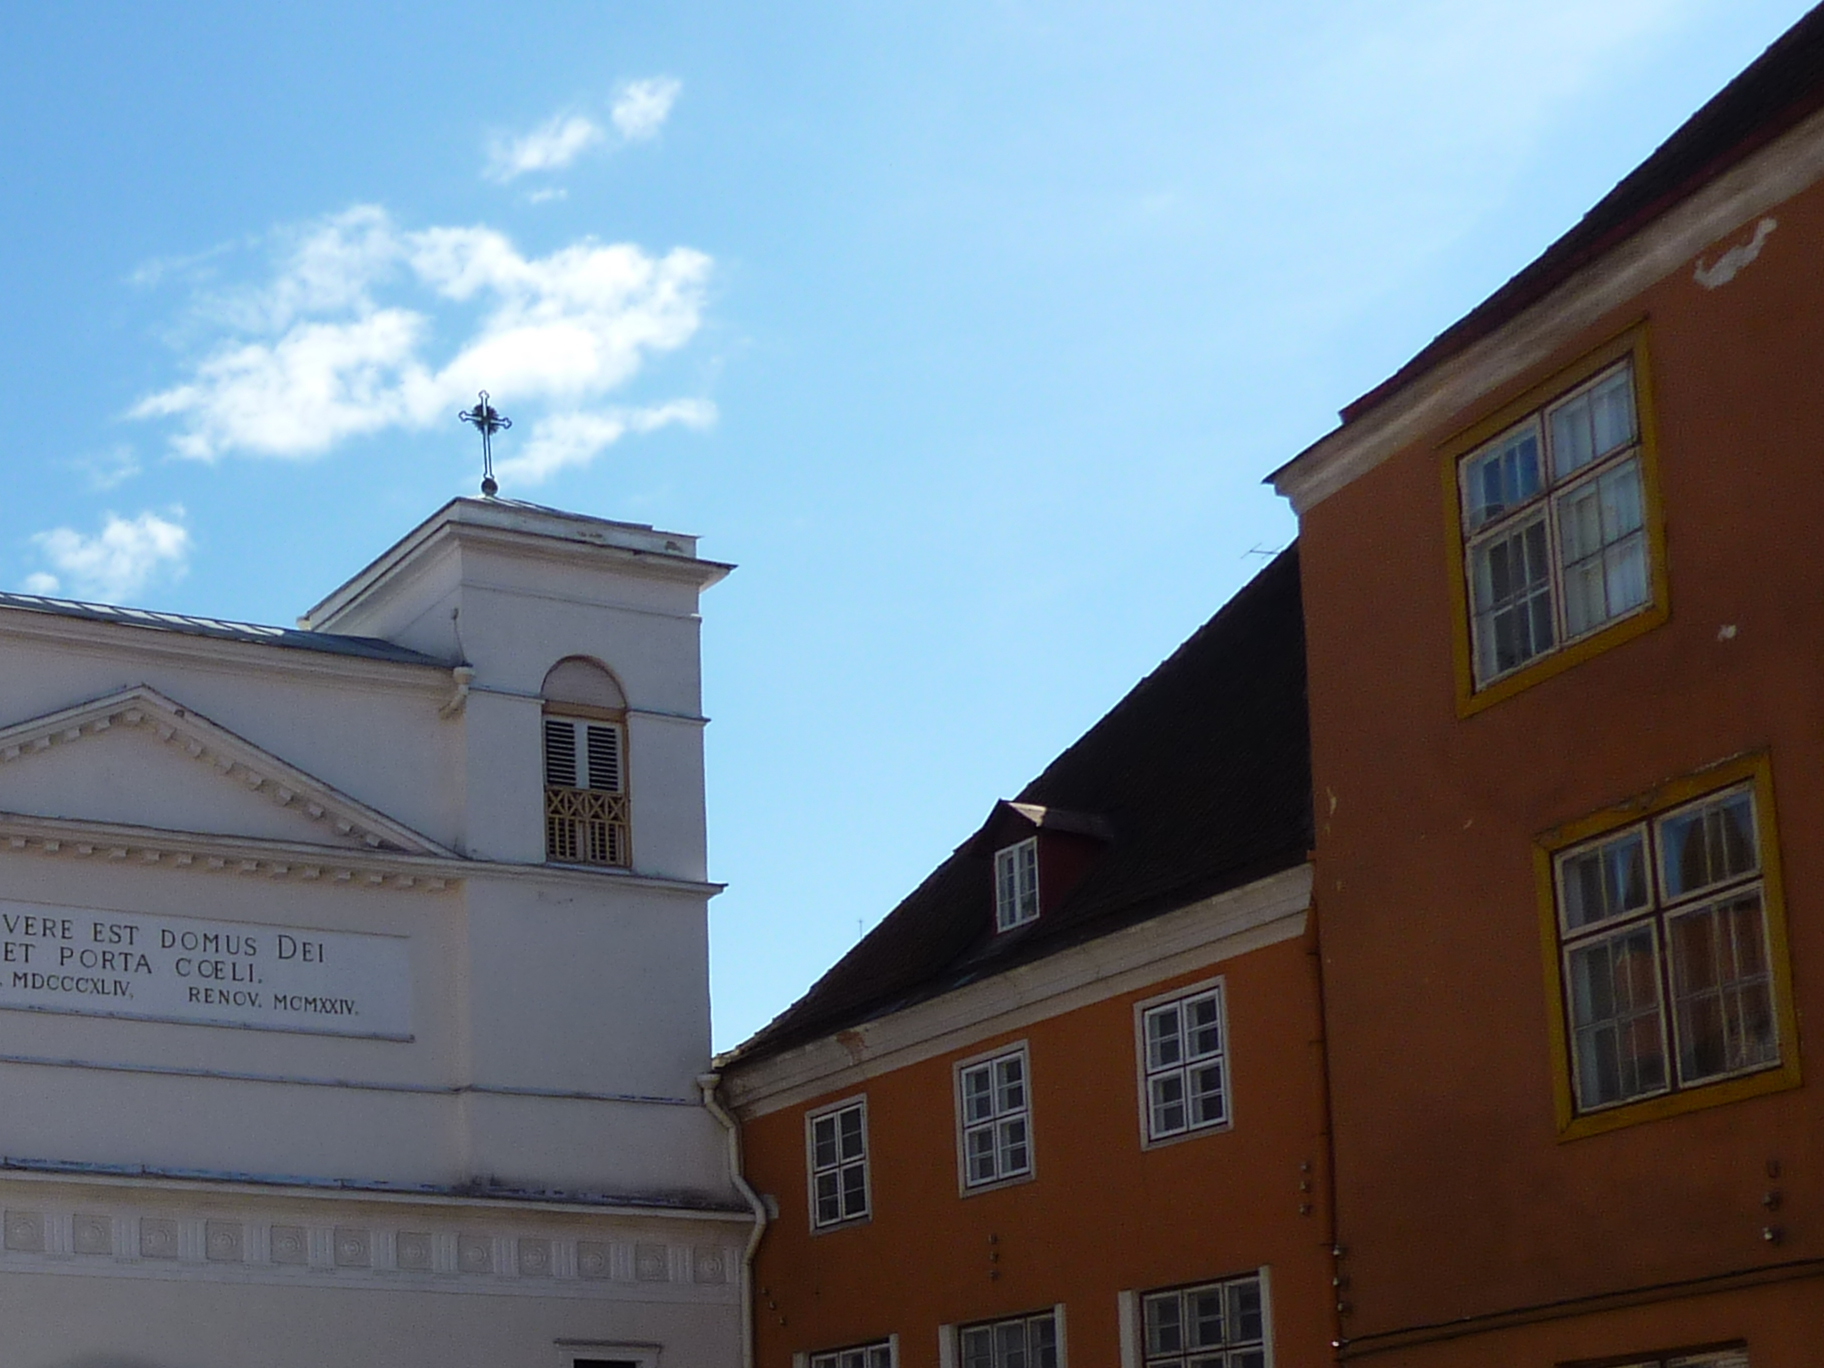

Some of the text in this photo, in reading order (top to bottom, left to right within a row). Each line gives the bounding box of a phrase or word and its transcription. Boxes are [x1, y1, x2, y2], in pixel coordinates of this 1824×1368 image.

[2, 914, 73, 939] VERE
[93, 923, 140, 946] EST
[161, 929, 257, 957] DOMUS
[4, 942, 36, 963] ET
[60, 947, 153, 974] PORTA
[189, 987, 262, 1008] RENOV.
